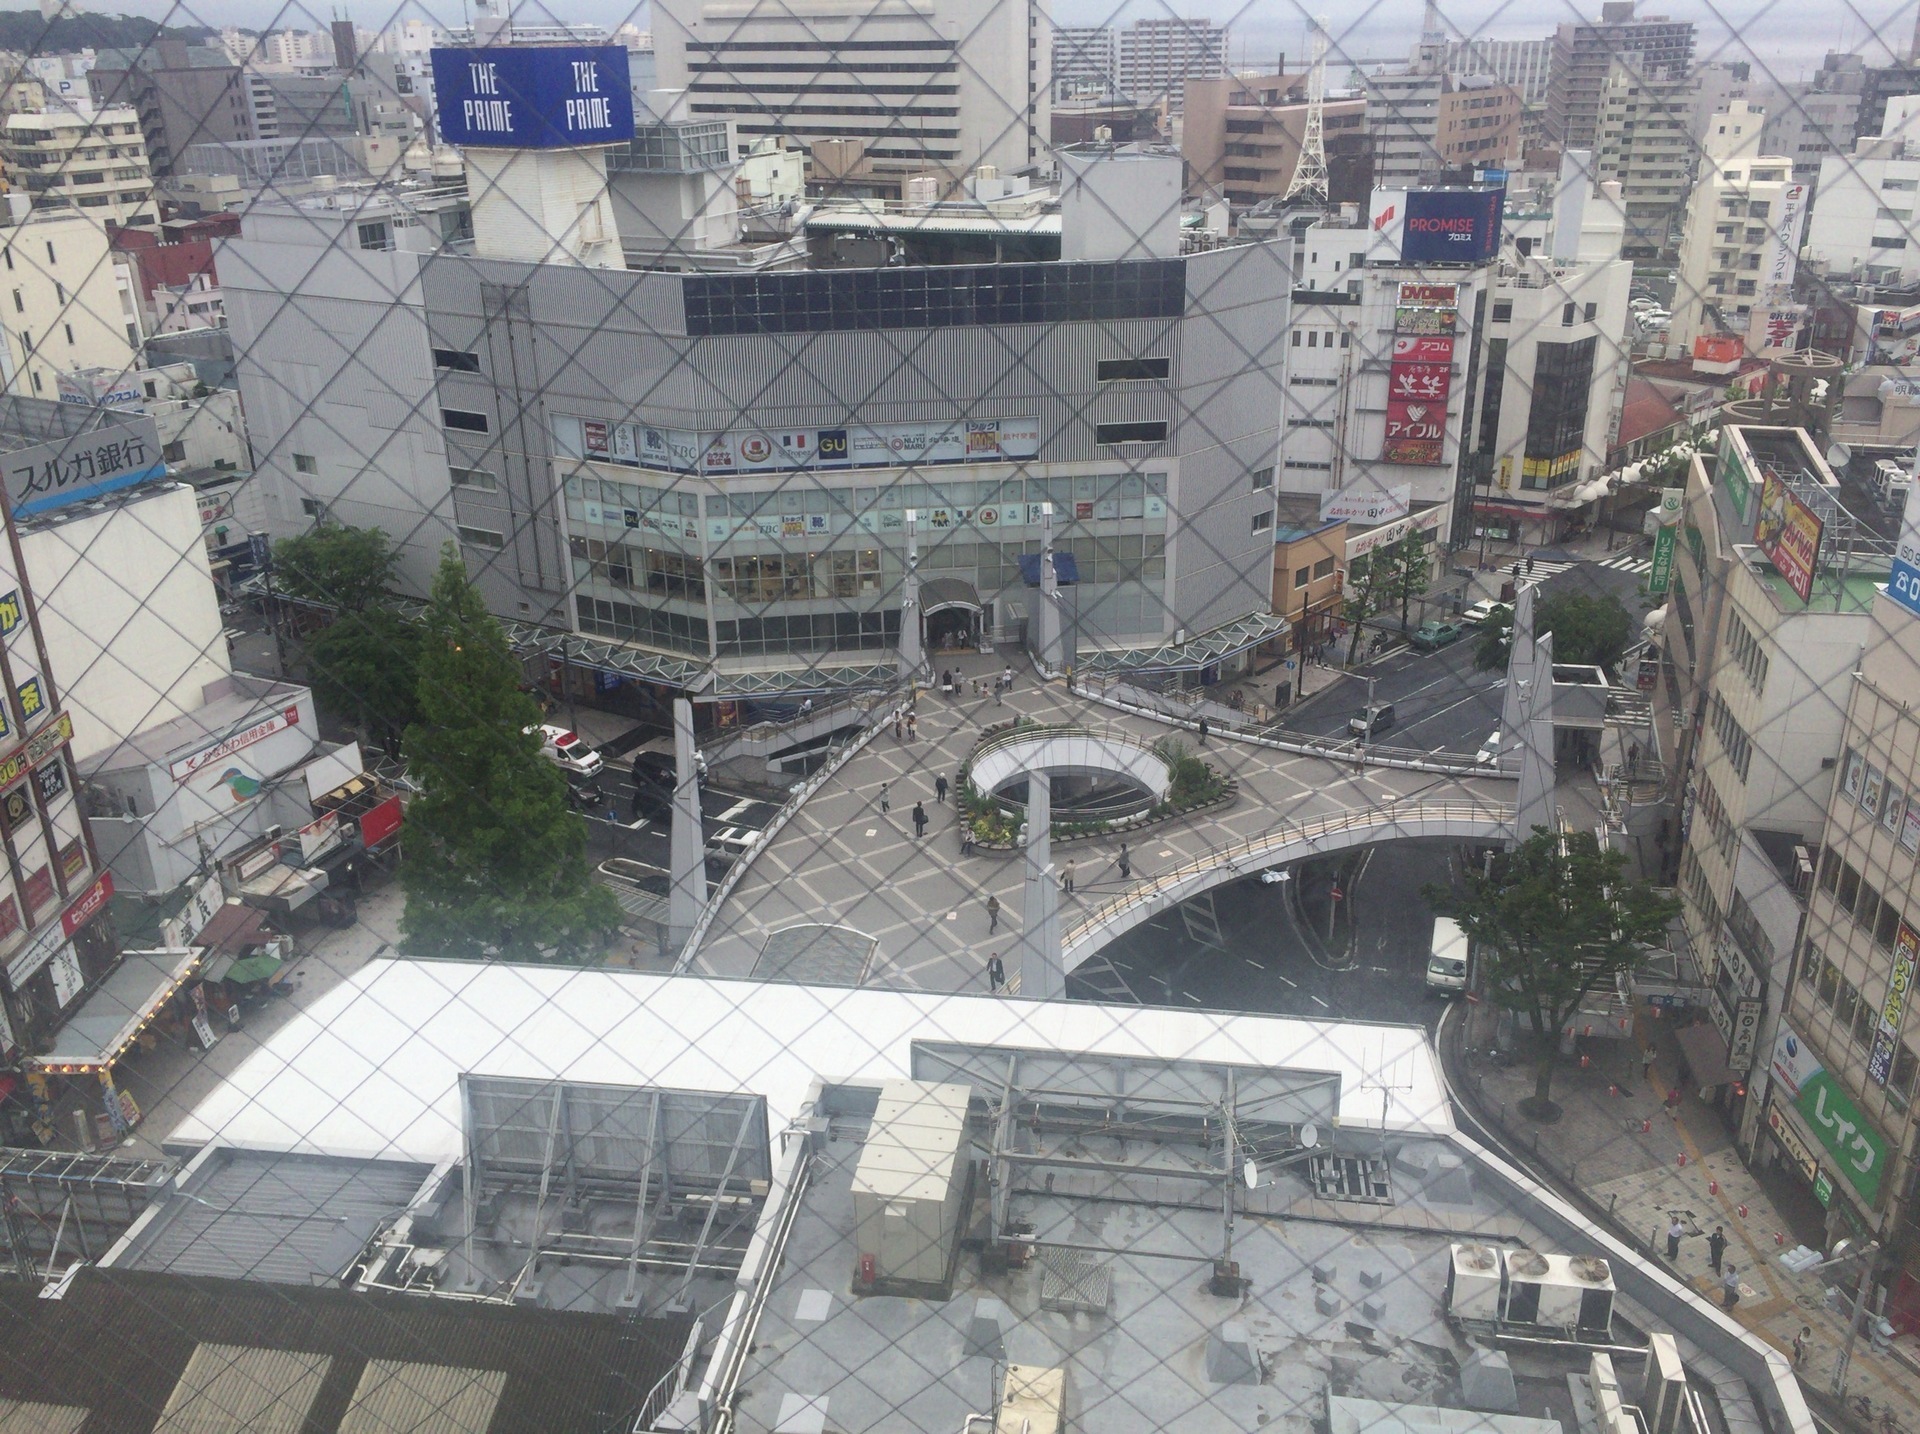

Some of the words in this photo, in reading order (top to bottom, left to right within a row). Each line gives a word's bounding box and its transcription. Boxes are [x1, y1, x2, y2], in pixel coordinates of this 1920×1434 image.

[468, 62, 499, 95] THE
[571, 61, 599, 93] THE
[463, 99, 514, 132] PRIME
[565, 97, 612, 131] PRIME
[1409, 218, 1474, 233] PROMISE
[1484, 195, 1497, 253] PROMISE
[1448, 233, 1472, 241] プロミス
[1421, 342, 1450, 351] アコム
[98, 389, 142, 405] ハウスコム
[970, 423, 995, 431] シルク
[1389, 422, 1441, 439] アイフル
[672, 444, 697, 459] TBC
[820, 438, 846, 452] GU
[12, 435, 146, 499] スルガ銀行
[760, 524, 779, 534] TBC
[1901, 544, 1914, 562] ISO
[1788, 560, 1808, 596] アビバ
[1815, 1085, 1875, 1173] レイク
